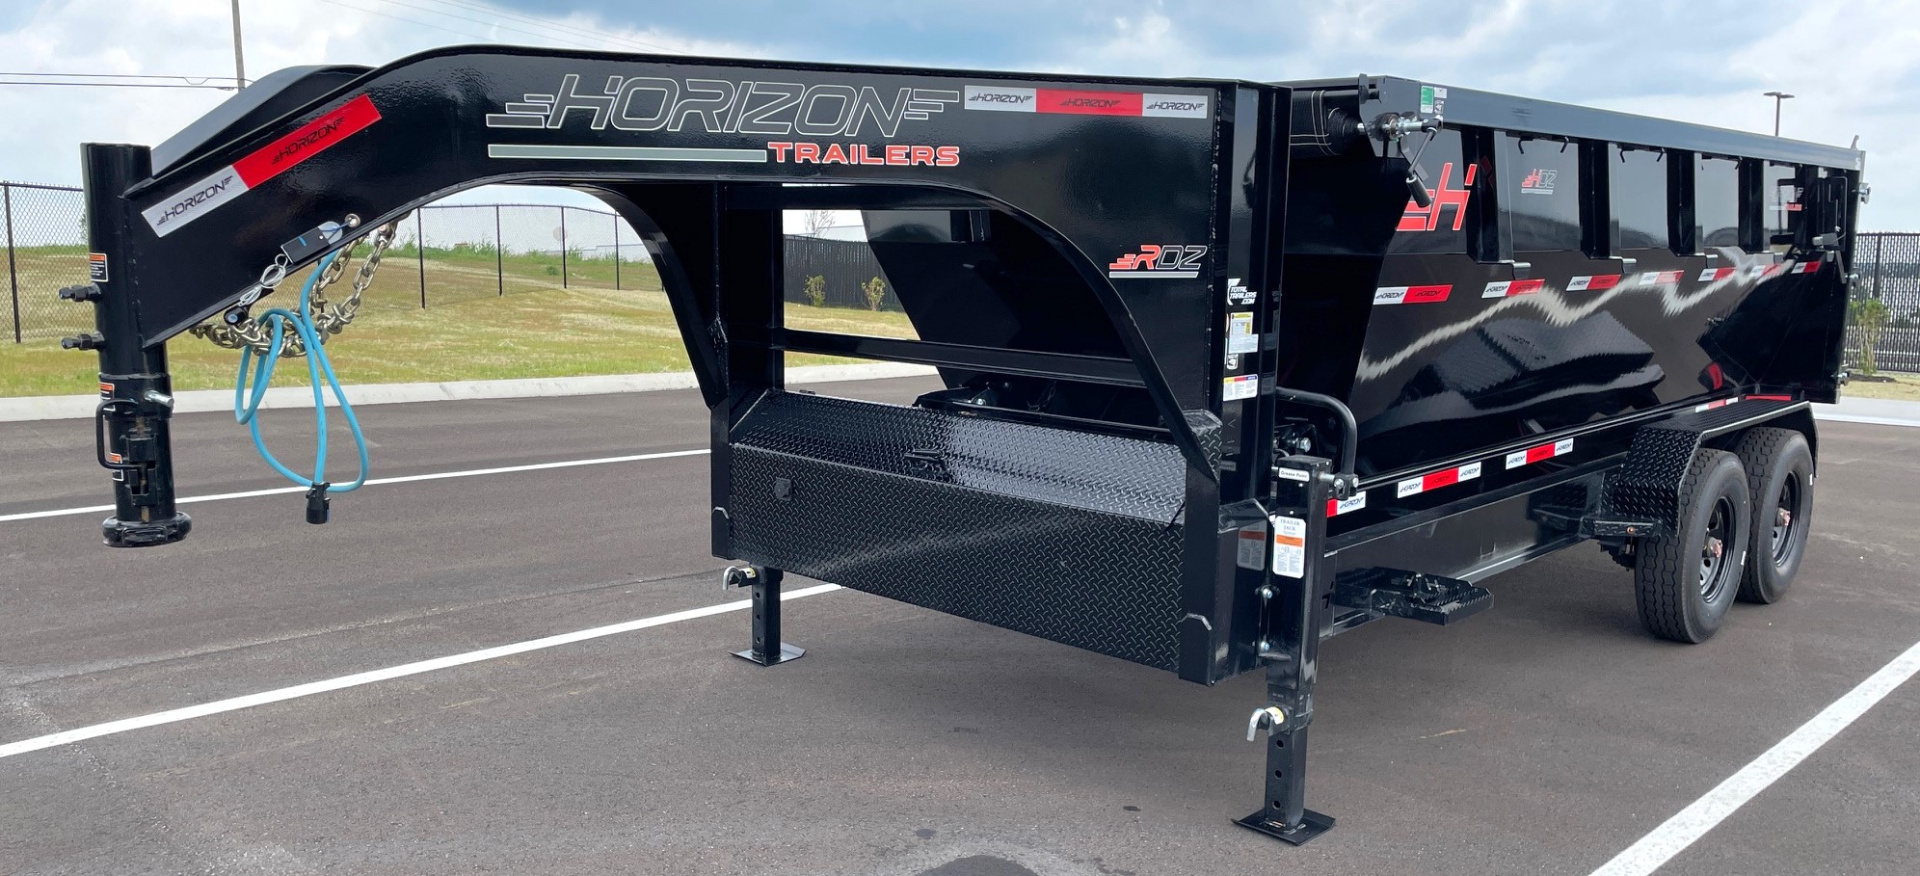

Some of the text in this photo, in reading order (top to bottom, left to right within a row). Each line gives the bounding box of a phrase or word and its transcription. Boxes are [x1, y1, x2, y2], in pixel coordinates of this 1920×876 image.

[547, 73, 912, 138] HORIZON
[976, 91, 1026, 104] HORIZON
[1066, 97, 1115, 109] HORIZON
[1152, 100, 1200, 112] HORIZON
[278, 121, 338, 163] HORIZON
[767, 141, 961, 167] TRAILERS
[163, 177, 228, 222] HORIZON
[1130, 245, 1208, 271] RDZ
